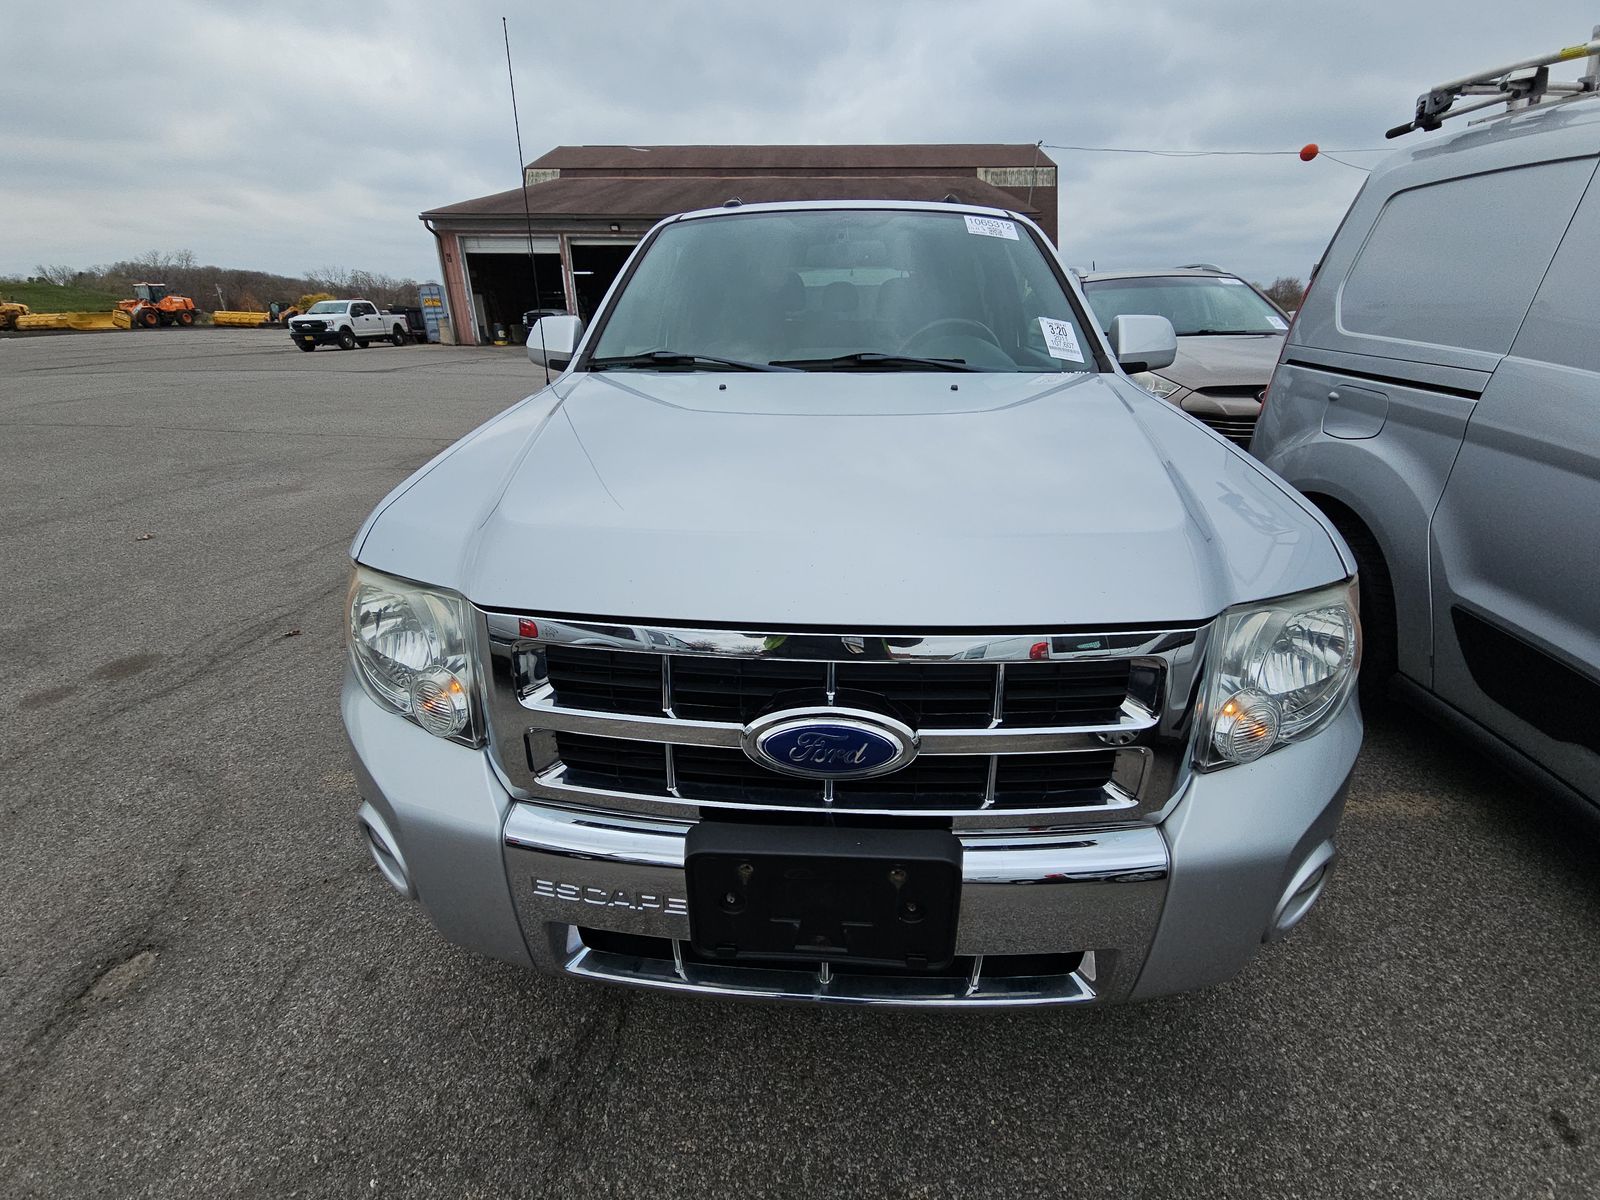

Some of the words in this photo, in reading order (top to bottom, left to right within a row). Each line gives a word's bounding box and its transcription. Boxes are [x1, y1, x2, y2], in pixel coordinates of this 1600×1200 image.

[1049, 324, 1068, 337] 3:20
[789, 731, 868, 764] Ford
[531, 877, 688, 915] ESCAPE
